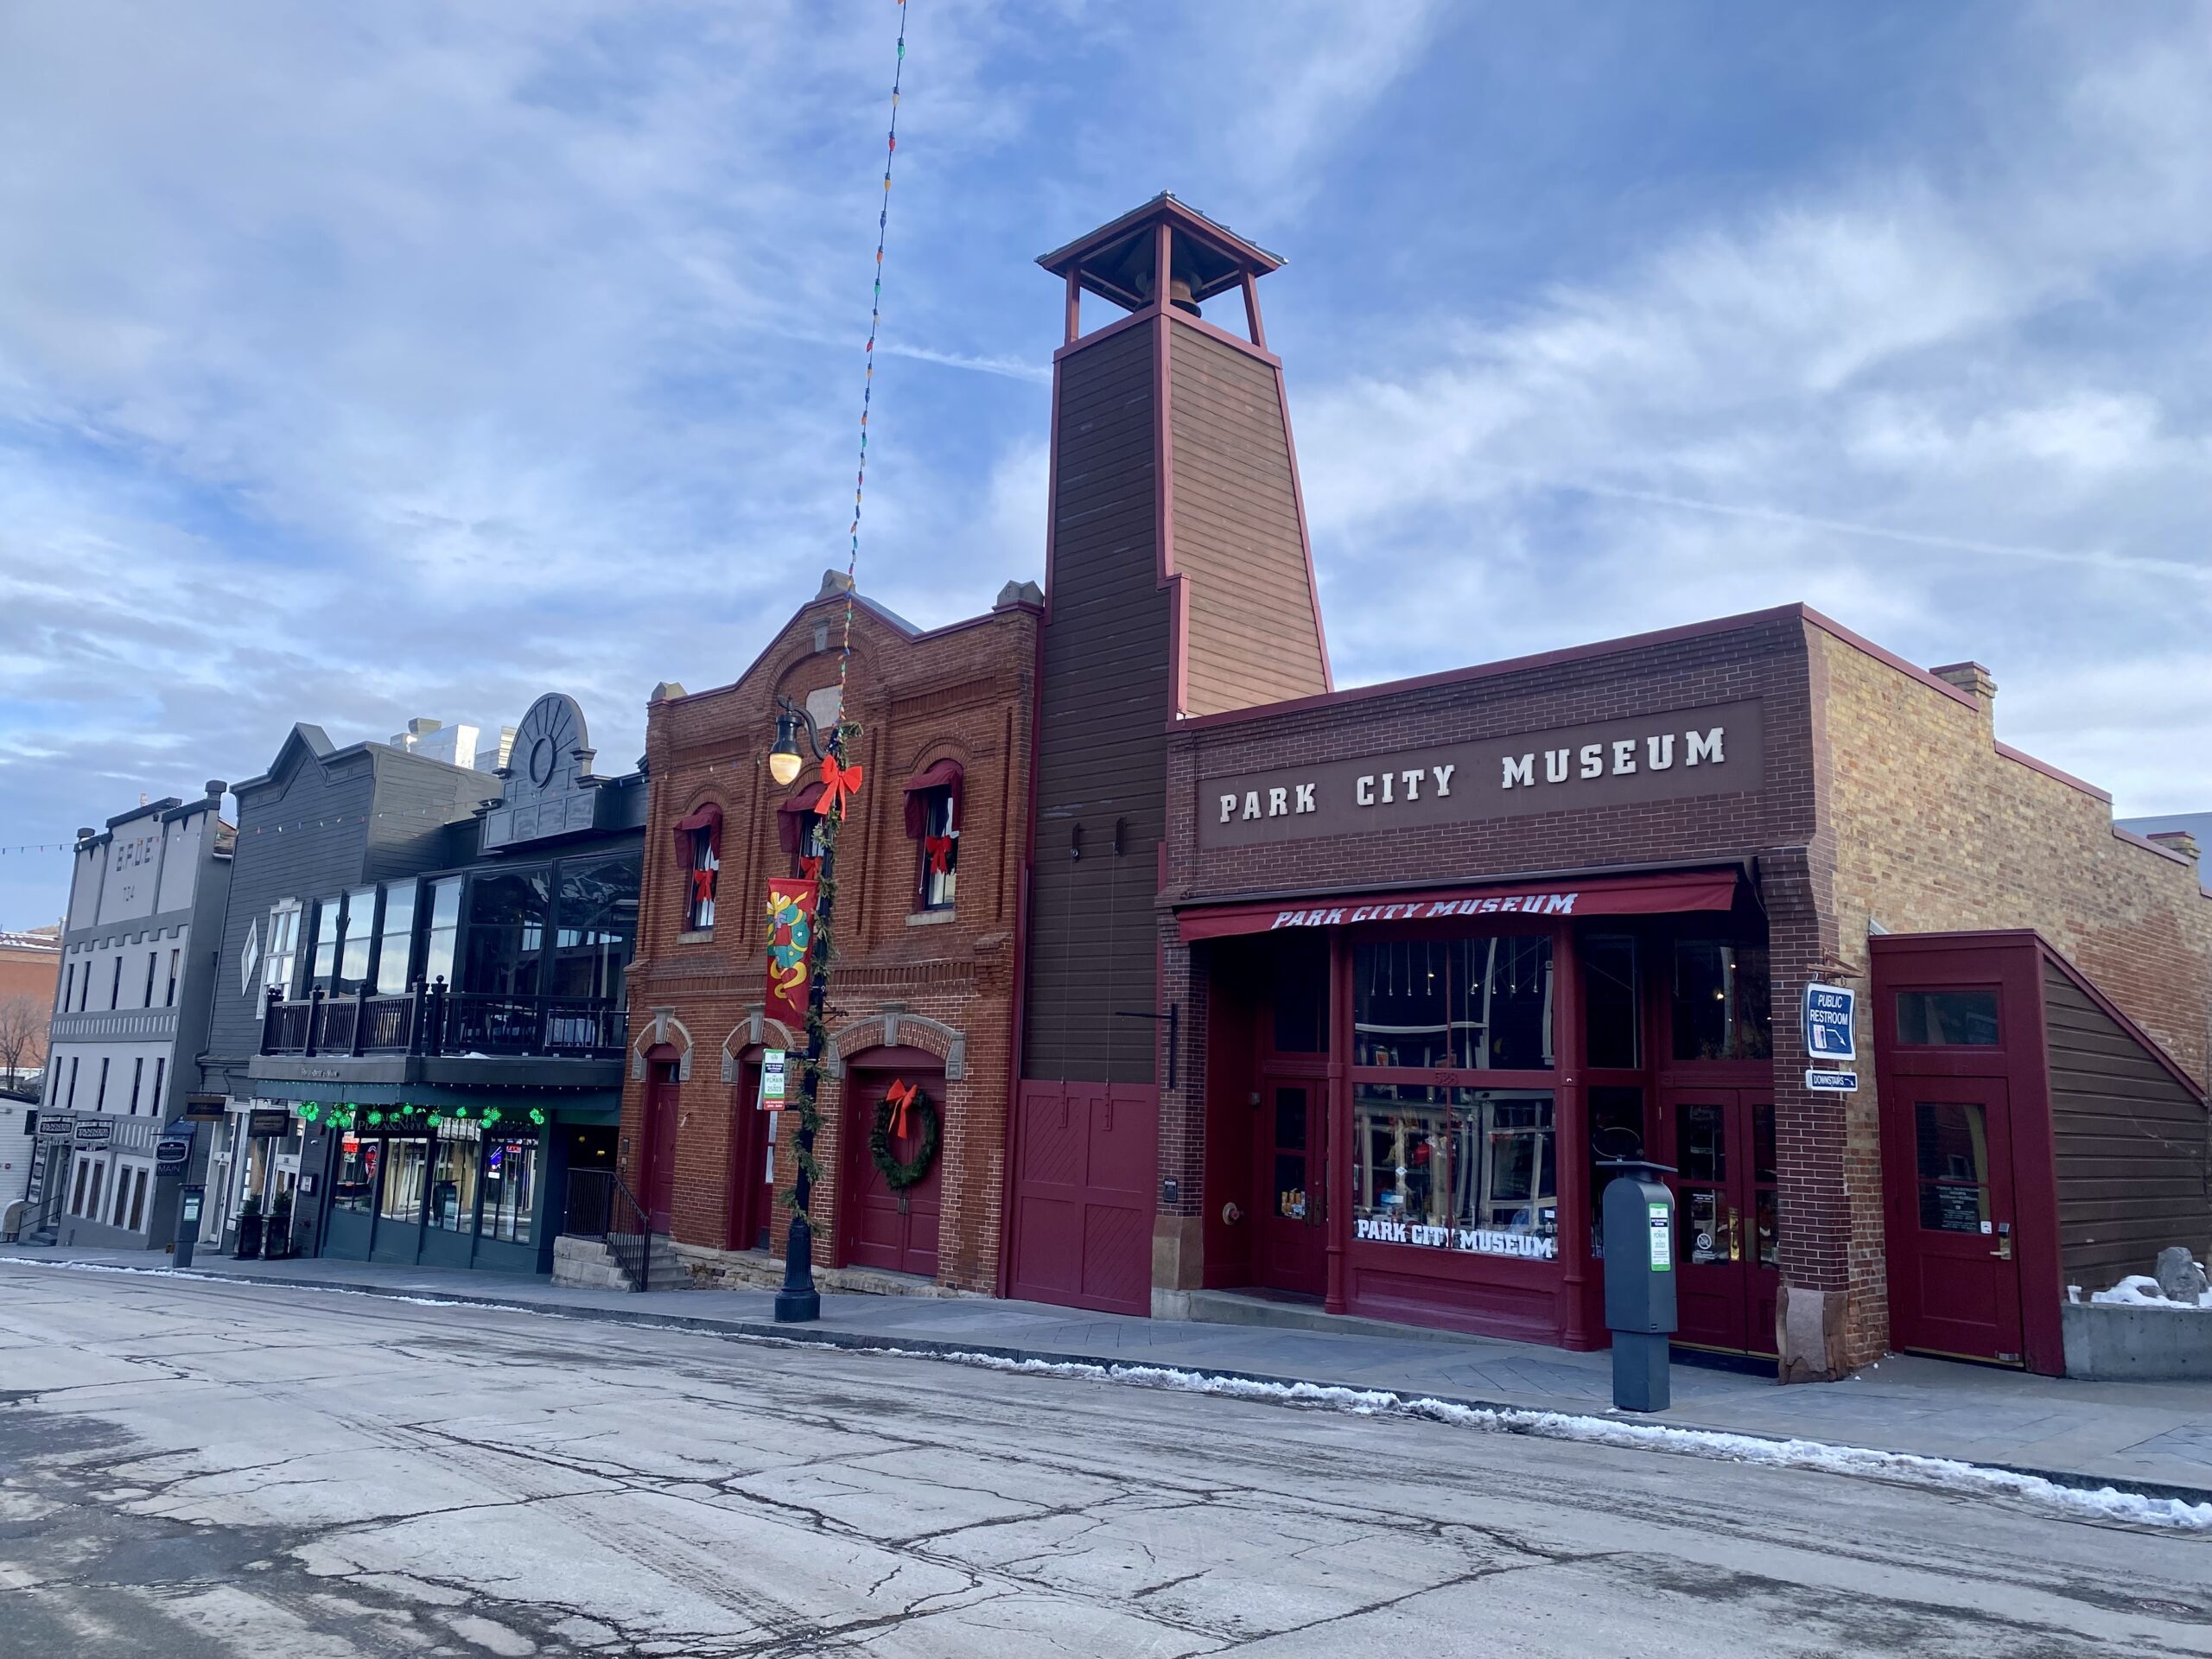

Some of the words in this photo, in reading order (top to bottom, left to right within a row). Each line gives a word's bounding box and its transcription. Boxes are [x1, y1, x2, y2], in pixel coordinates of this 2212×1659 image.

[1219, 784, 1316, 823] PARK
[1357, 765, 1455, 806] CITY
[1502, 728, 1725, 789] MUSEUM
[1271, 908, 1347, 930] PARK
[1351, 903, 1425, 922] CITY
[1426, 893, 1579, 918] MUSEUM
[1817, 995, 1842, 1008] PUBLIC
[1810, 1009, 1847, 1026] RESTROOM
[158, 1165, 181, 1173] MAIN
[1357, 1220, 1406, 1242] PARK
[1411, 1224, 1455, 1247] CITY
[1459, 1228, 1553, 1258] MUSEUM
